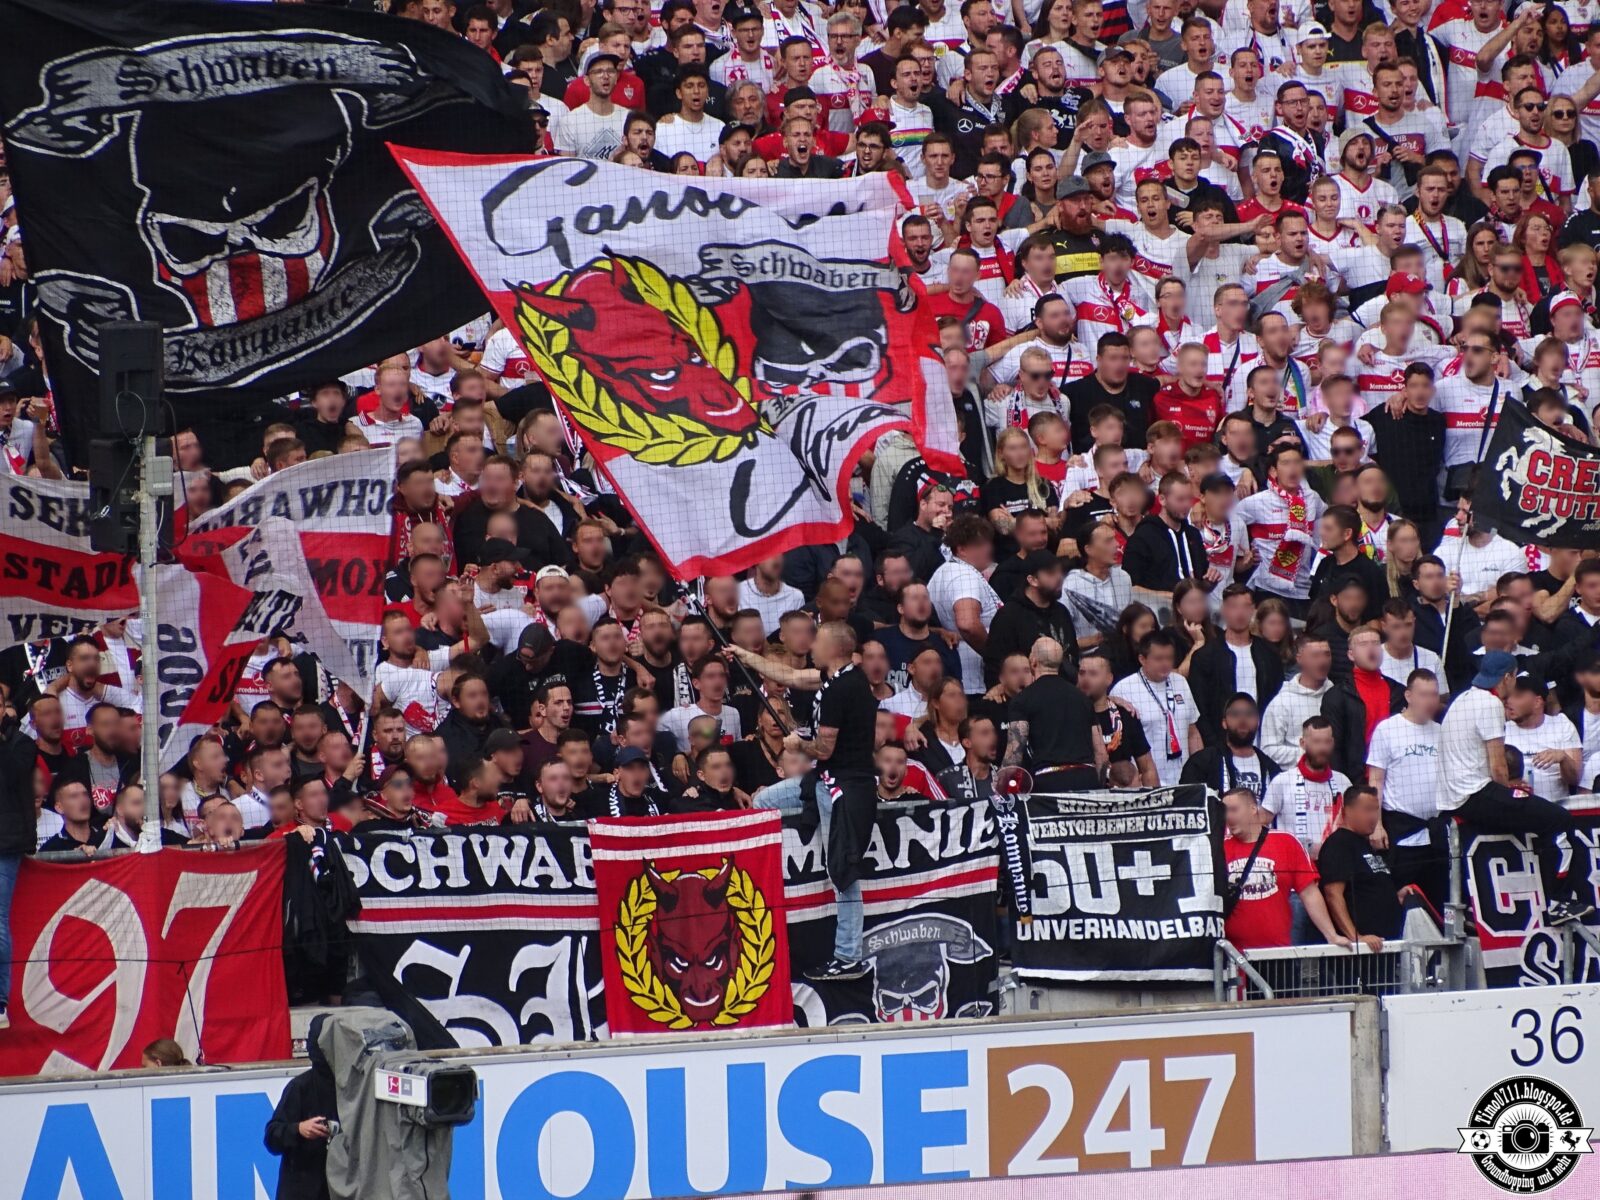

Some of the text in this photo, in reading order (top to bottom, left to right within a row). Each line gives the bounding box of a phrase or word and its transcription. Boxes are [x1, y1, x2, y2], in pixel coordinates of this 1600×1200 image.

[116, 50, 338, 100] Schwaben
[730, 250, 879, 289] Schwaben
[1527, 449, 1600, 494] CRE
[1031, 812, 1207, 839] VERSTORBENEN ULTRAS
[1028, 835, 1224, 916] 50+1
[868, 922, 941, 954] Schwaben
[22, 869, 259, 1073] 97
[1510, 1004, 1585, 1067] 36
[1003, 1053, 1238, 1176] 247
